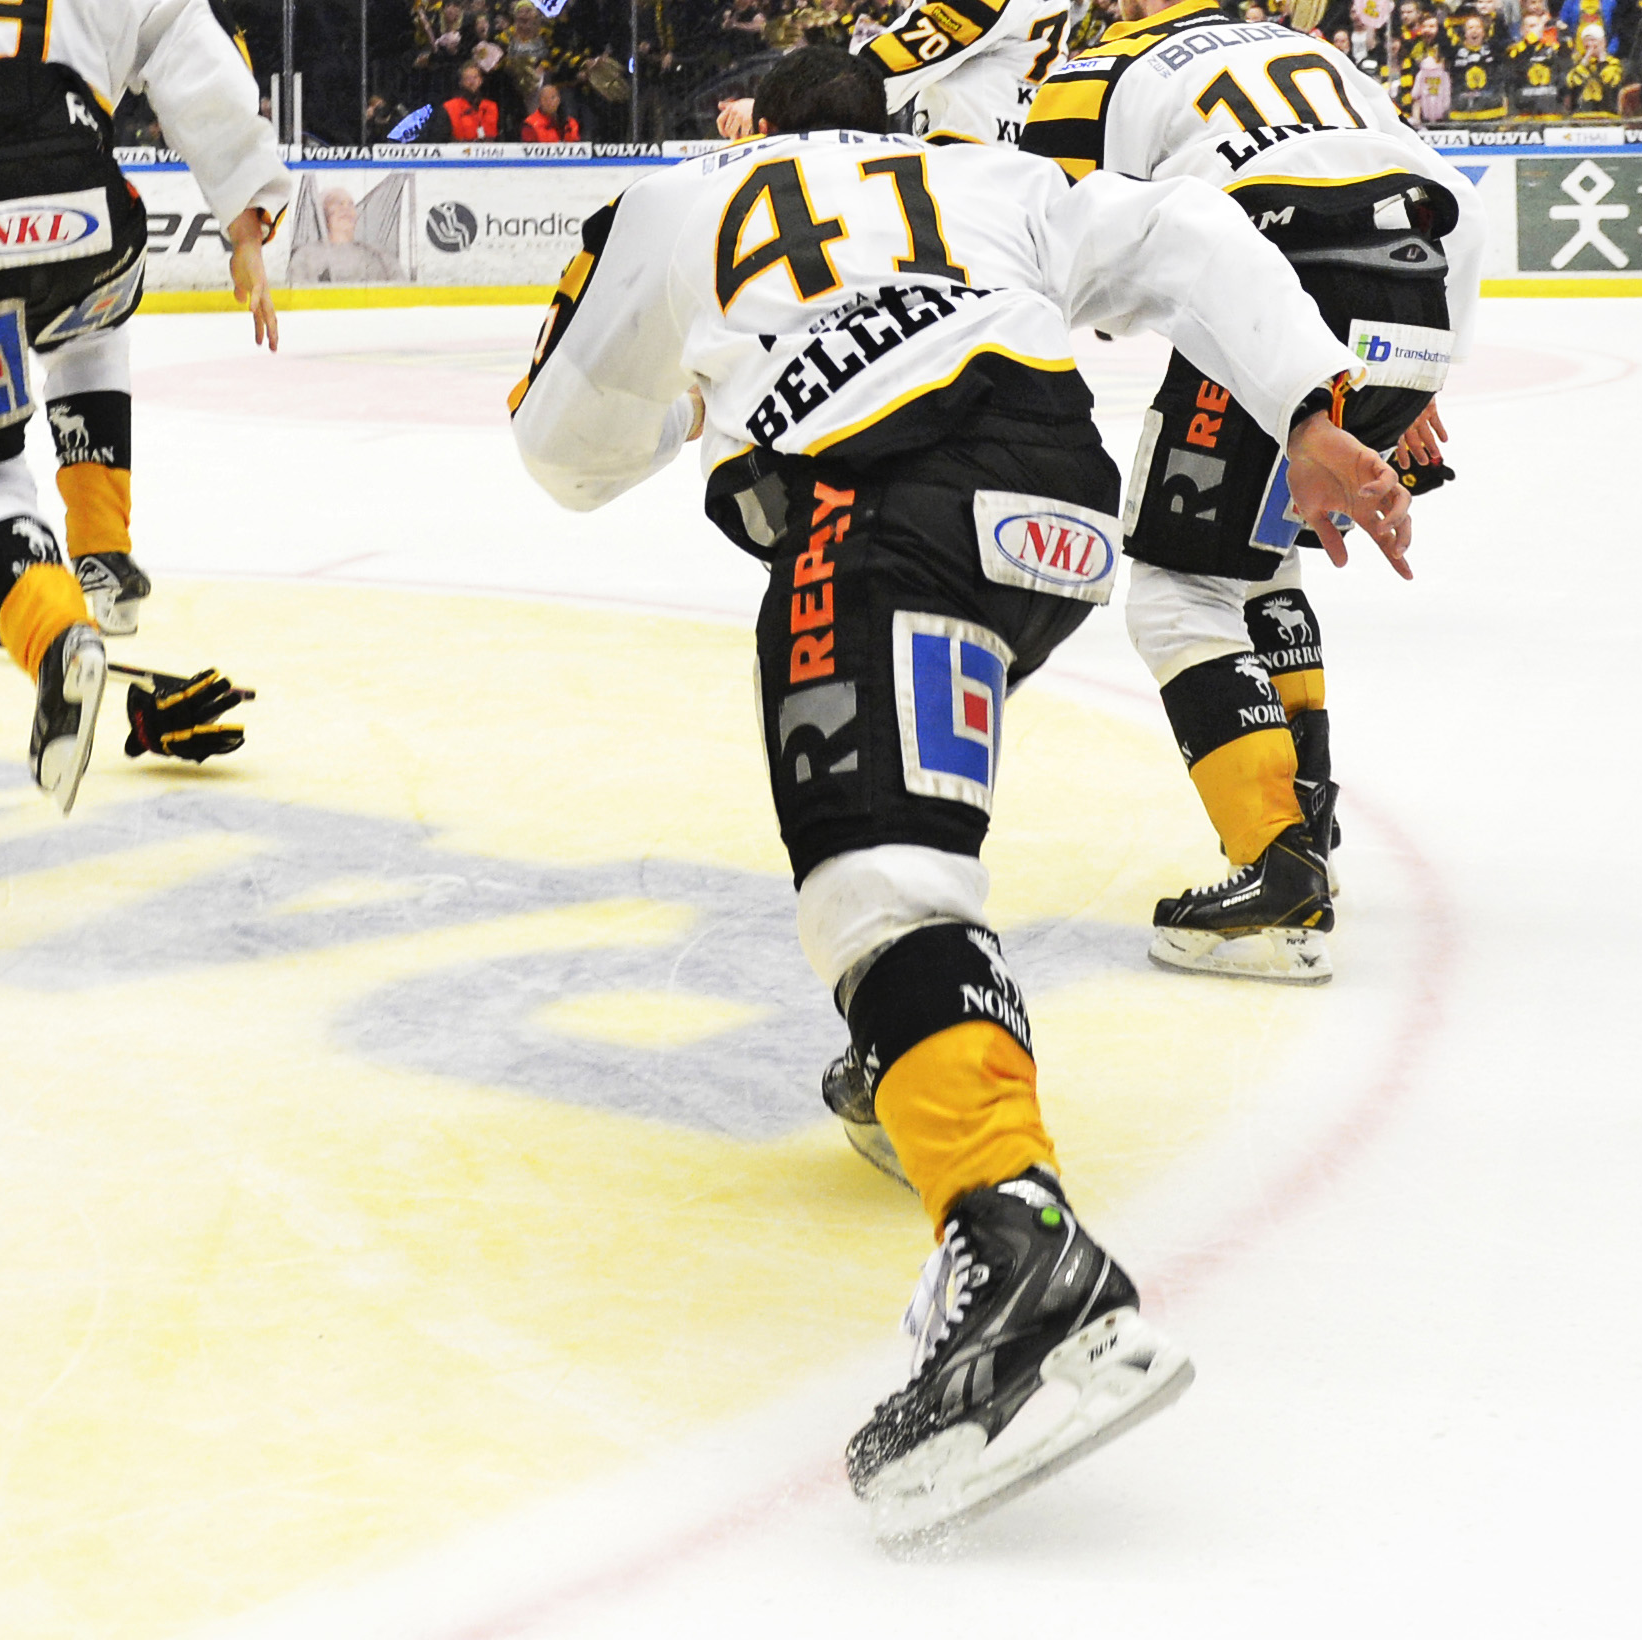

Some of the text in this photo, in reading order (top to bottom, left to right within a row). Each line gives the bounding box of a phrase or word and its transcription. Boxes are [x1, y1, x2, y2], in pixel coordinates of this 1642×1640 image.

[901, 16, 951, 61] 70
[1157, 24, 1309, 72] BOLIDE
[1192, 51, 1368, 133] 10
[594, 142, 663, 158] VOLVIA
[1469, 130, 1544, 147] VOLVIA
[304, 145, 373, 161] VOLVIA
[378, 146, 442, 159] VOLVIA
[523, 146, 587, 158] VOLVIA
[486, 211, 580, 237] handic
[714, 152, 972, 317] 41
[1018, 519, 1099, 578] NKL
